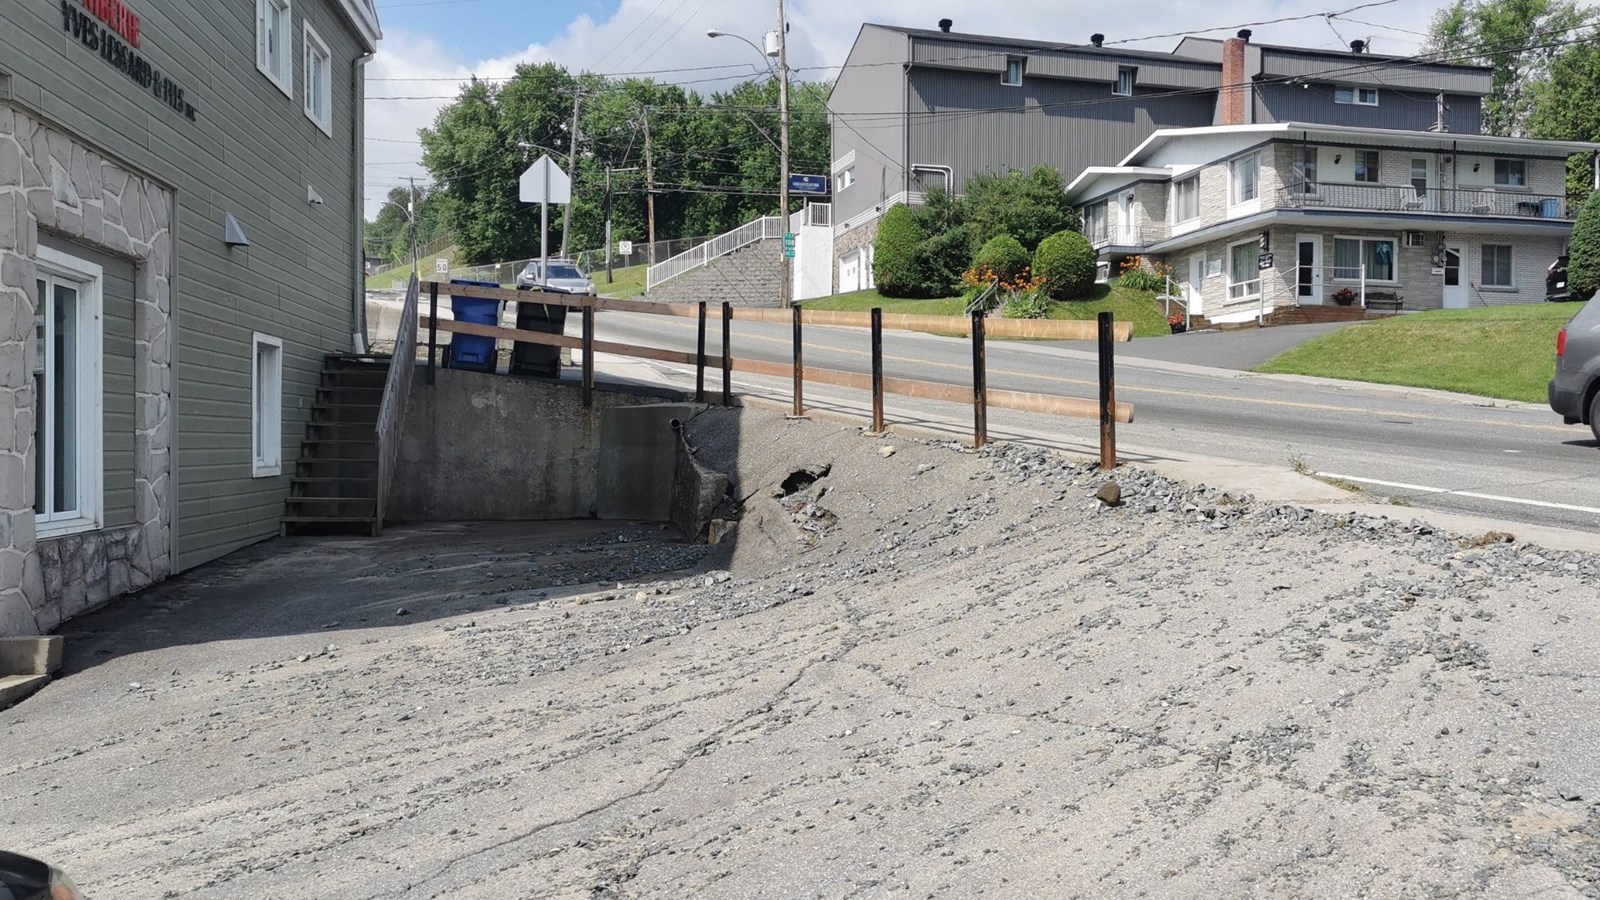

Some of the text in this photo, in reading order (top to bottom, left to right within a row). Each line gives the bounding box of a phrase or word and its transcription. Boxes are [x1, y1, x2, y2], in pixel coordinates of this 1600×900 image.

[61, 0, 99, 50] YVES
[100, 29, 152, 88] LESSARD
[152, 70, 162, 98] &
[162, 77, 185, 113] FILS
